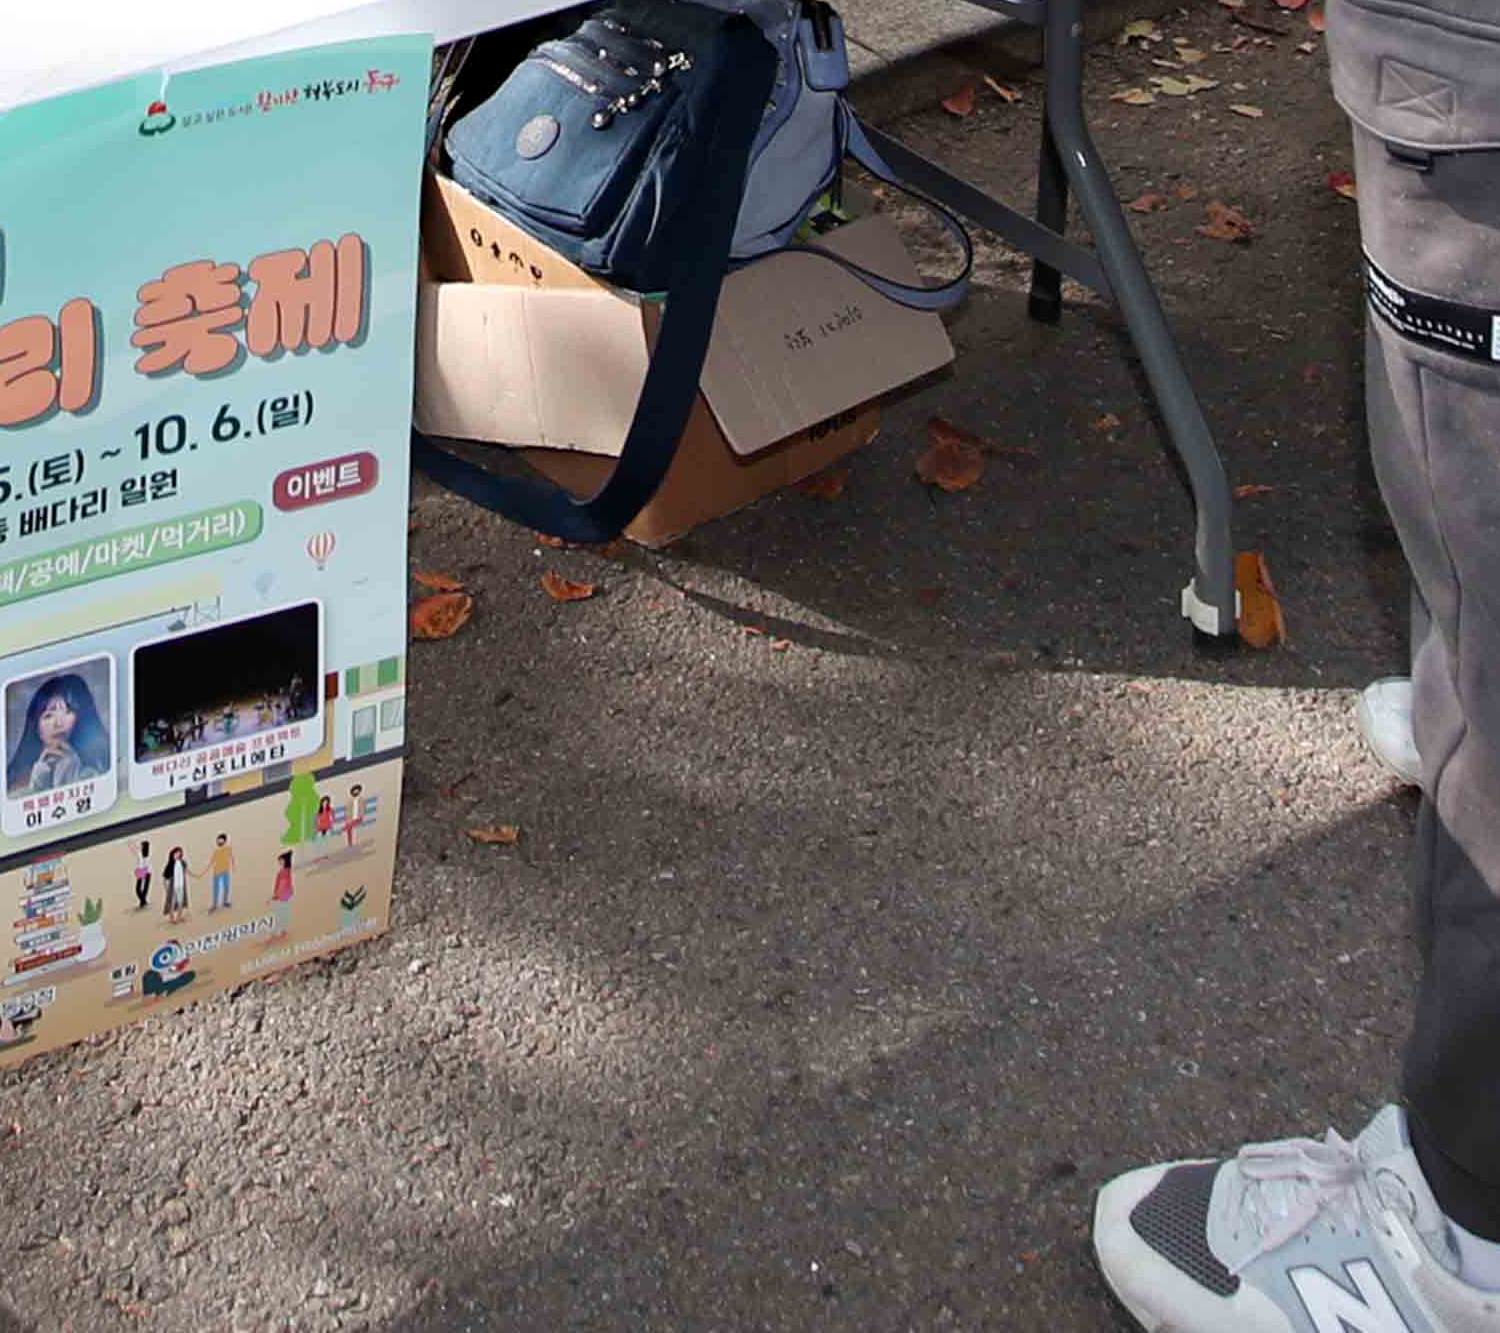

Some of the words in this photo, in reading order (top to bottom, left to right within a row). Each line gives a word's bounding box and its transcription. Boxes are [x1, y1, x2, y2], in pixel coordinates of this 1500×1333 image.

[131, 232, 368, 379] 축제
[132, 414, 200, 462] 10.
[210, 390, 315, 444] 6.(일)
[18, 487, 110, 537] 배다리
[118, 466, 180, 508] 일원
[285, 459, 363, 501] 이벤트
